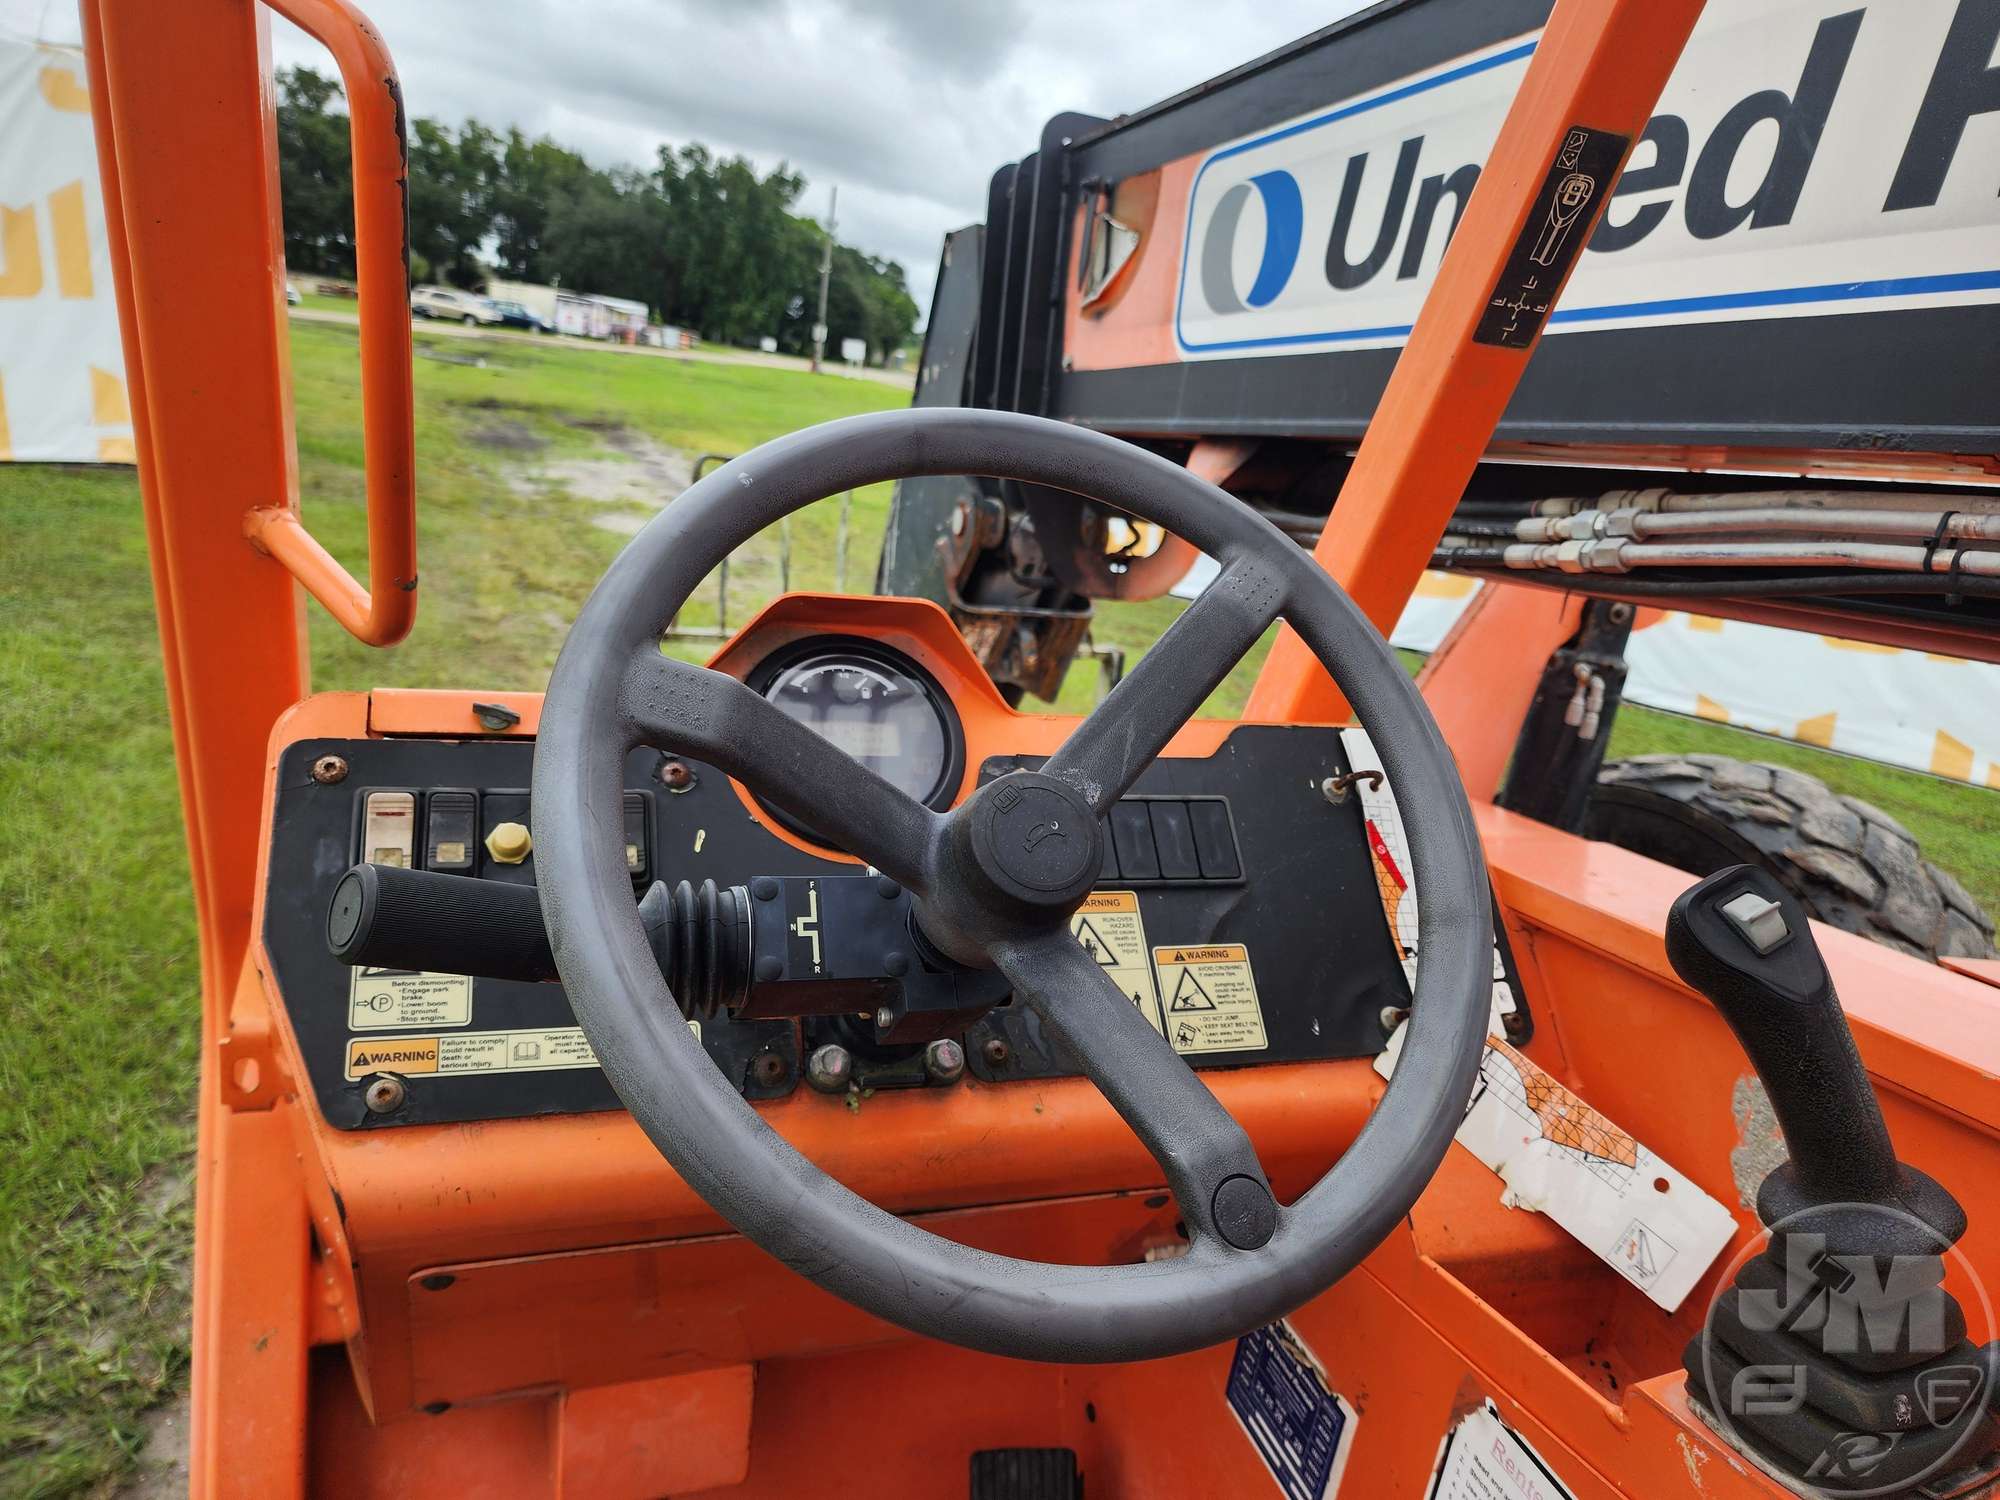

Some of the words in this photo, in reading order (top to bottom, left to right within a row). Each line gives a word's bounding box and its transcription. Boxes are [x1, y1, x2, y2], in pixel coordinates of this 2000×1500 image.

[1325, 7, 1867, 290] Uned
[1085, 899, 1121, 907] ARNING
[790, 923, 797, 931] N
[1186, 950, 1229, 959] WARNING
[814, 965, 821, 974] R
[559, 1047, 588, 1055] capacity
[370, 1051, 436, 1063] WARNING
